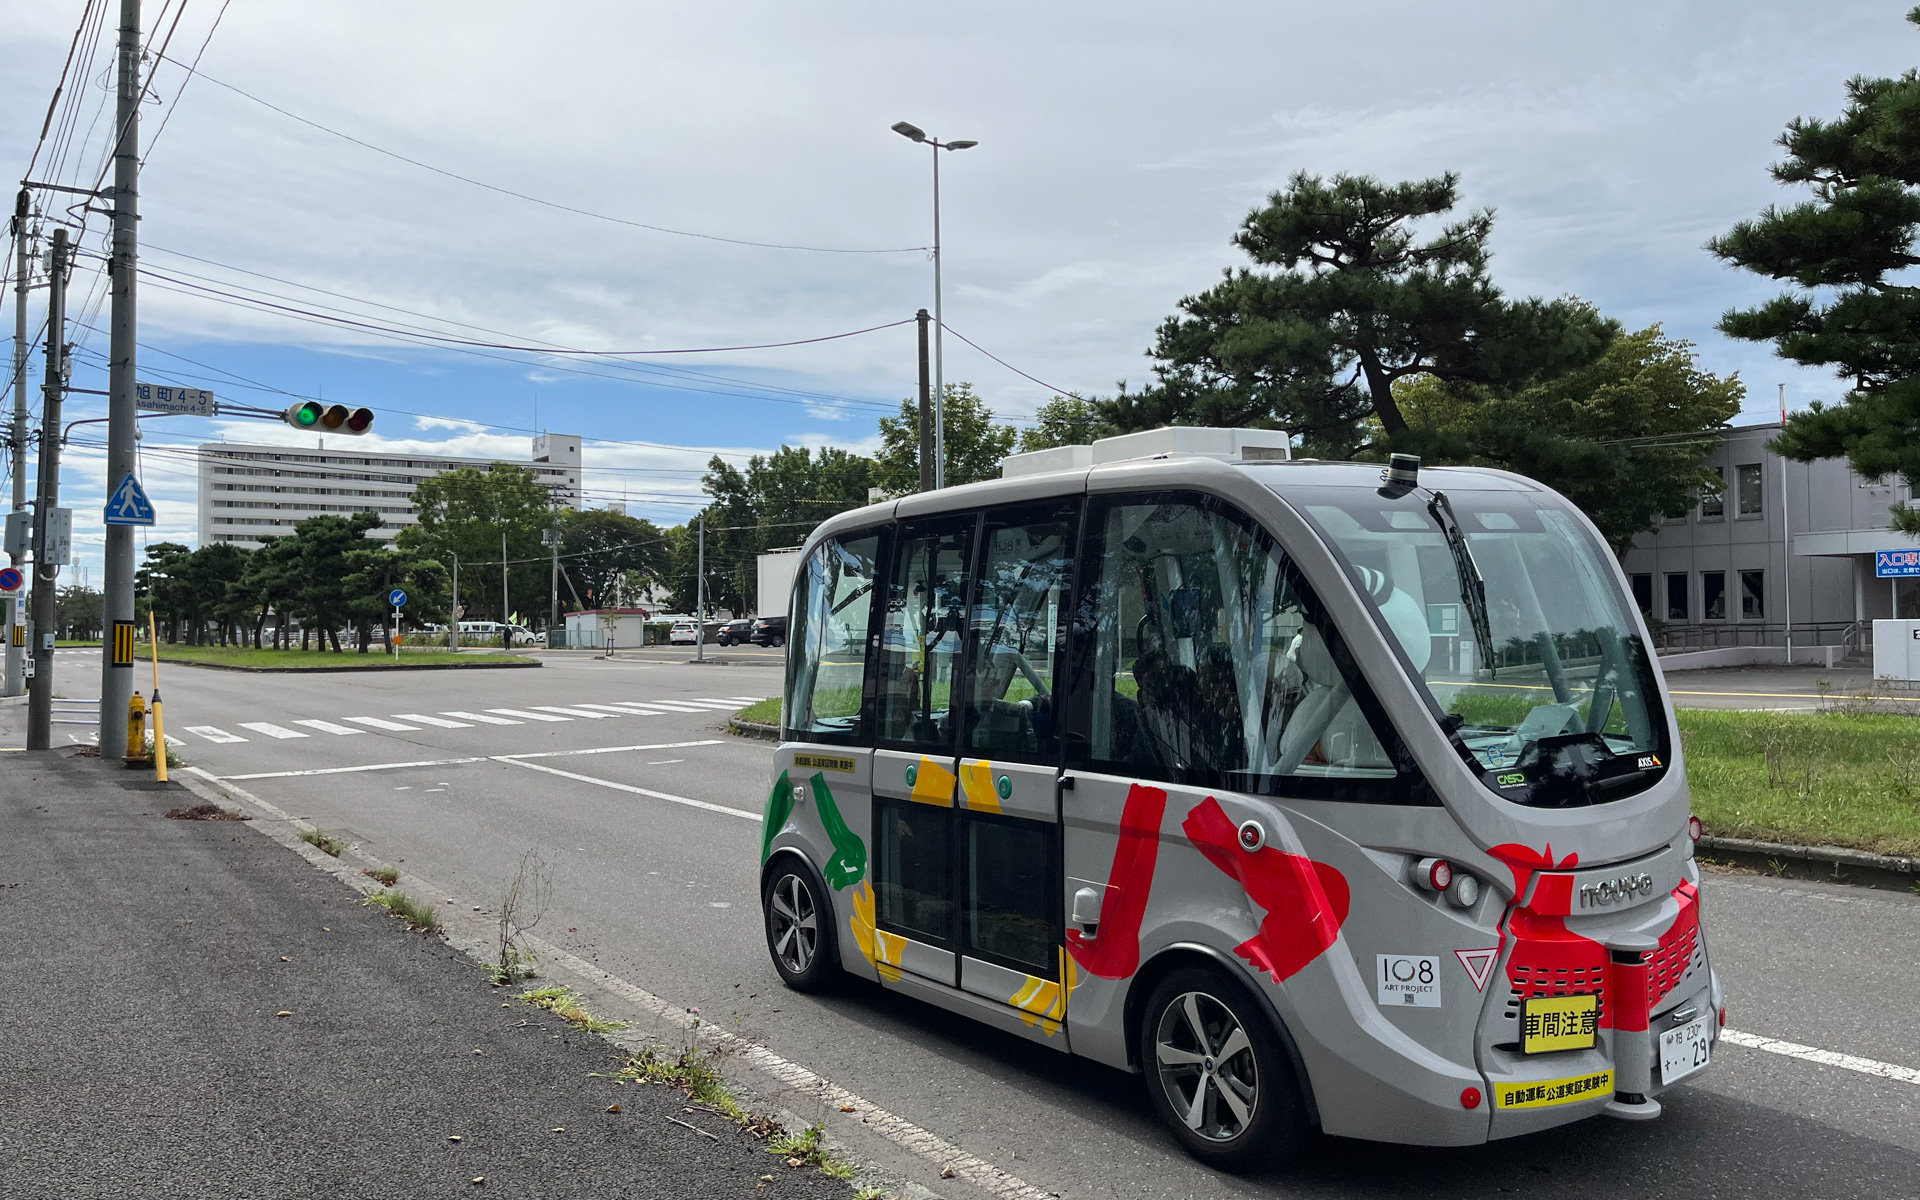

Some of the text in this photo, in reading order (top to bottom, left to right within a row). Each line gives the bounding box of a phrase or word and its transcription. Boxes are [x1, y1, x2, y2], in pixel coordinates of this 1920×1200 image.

[136, 384, 207, 405] 旭町 4-5
[136, 400, 207, 414] Asahimachi 4-5
[1878, 552, 1920, 567] 入口専
[1638, 756, 1653, 768] AXIS
[1384, 958, 1434, 984] 108
[1400, 985, 1433, 994] PROJECT
[1525, 1009, 1598, 1039] 車間注意
[1692, 1037, 1707, 1068] 29
